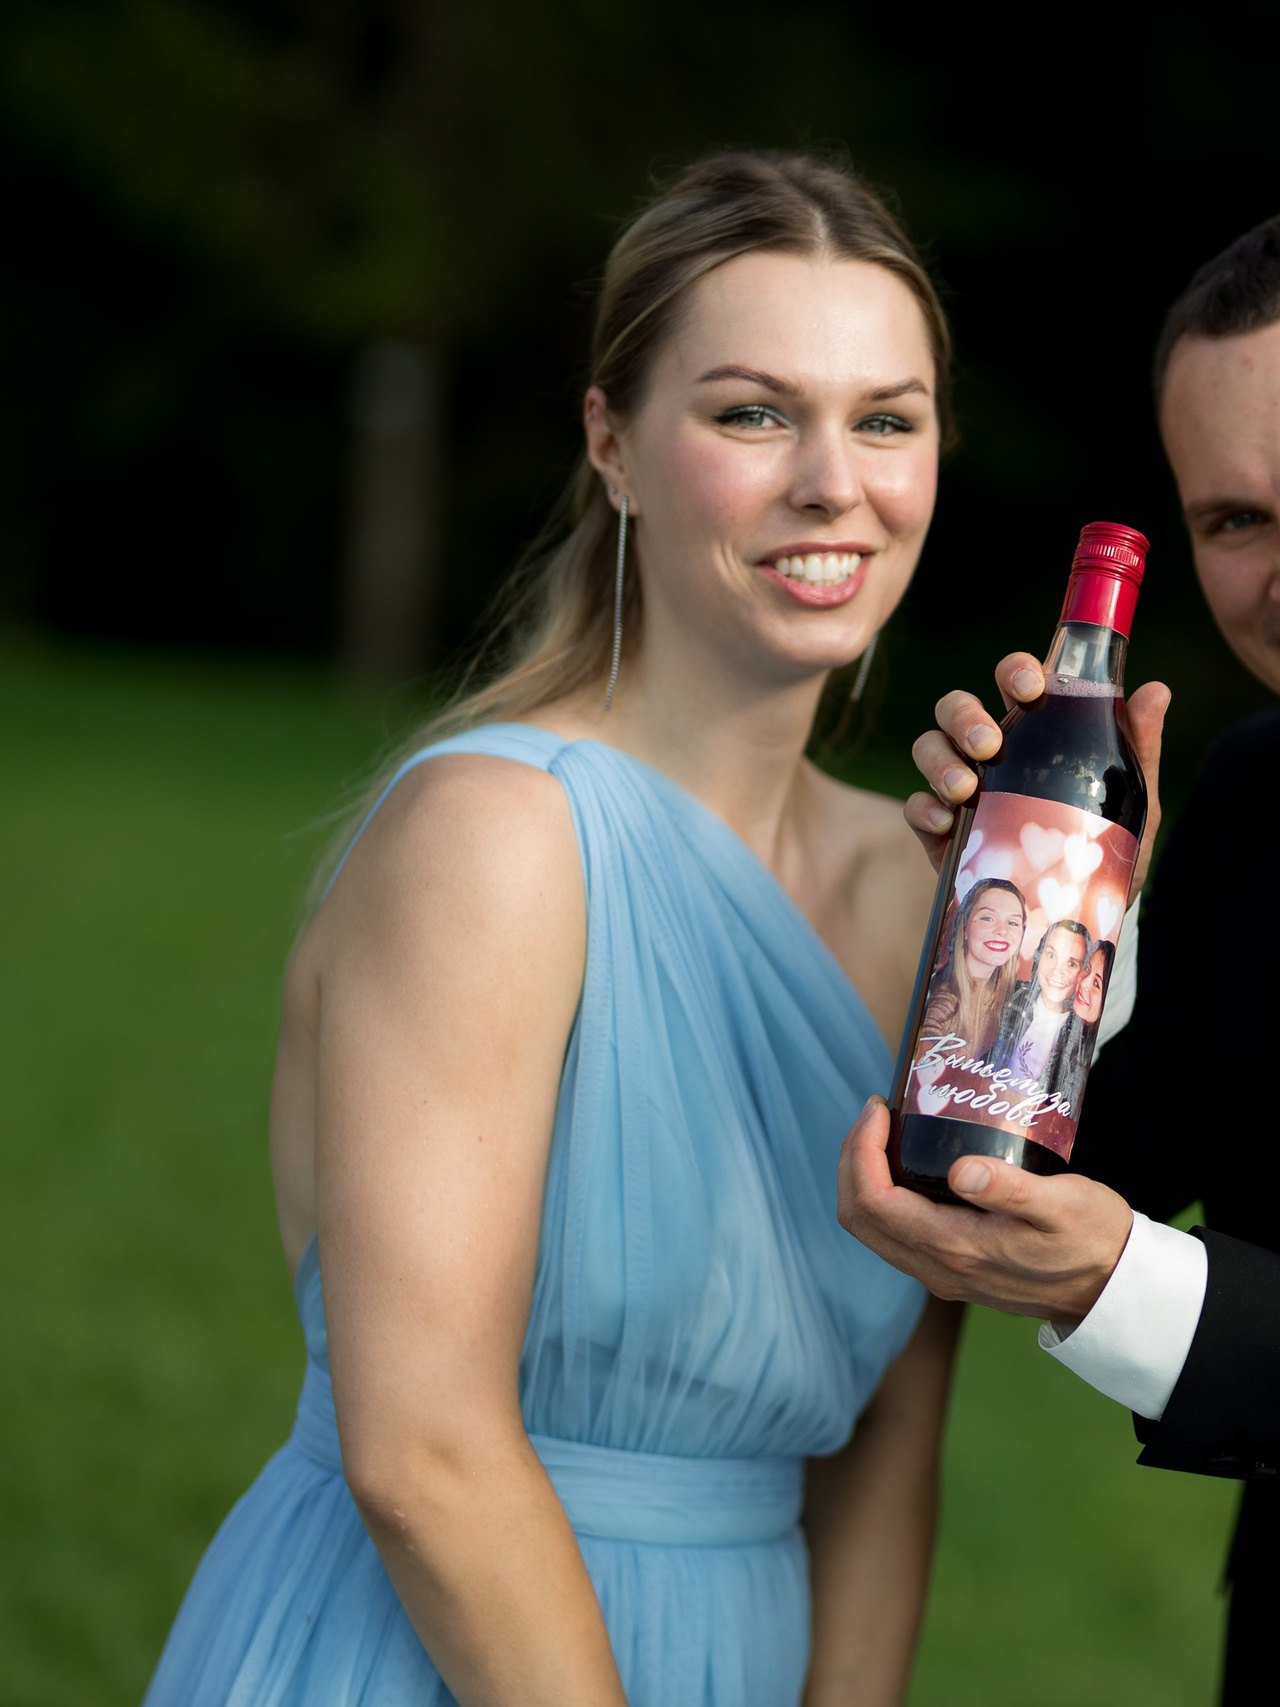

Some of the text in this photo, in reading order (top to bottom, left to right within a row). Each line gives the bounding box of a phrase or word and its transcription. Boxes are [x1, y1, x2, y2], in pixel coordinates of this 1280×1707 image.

[912, 1032, 1071, 1117] Выпьем за
[928, 1082, 1048, 1127] любовь
